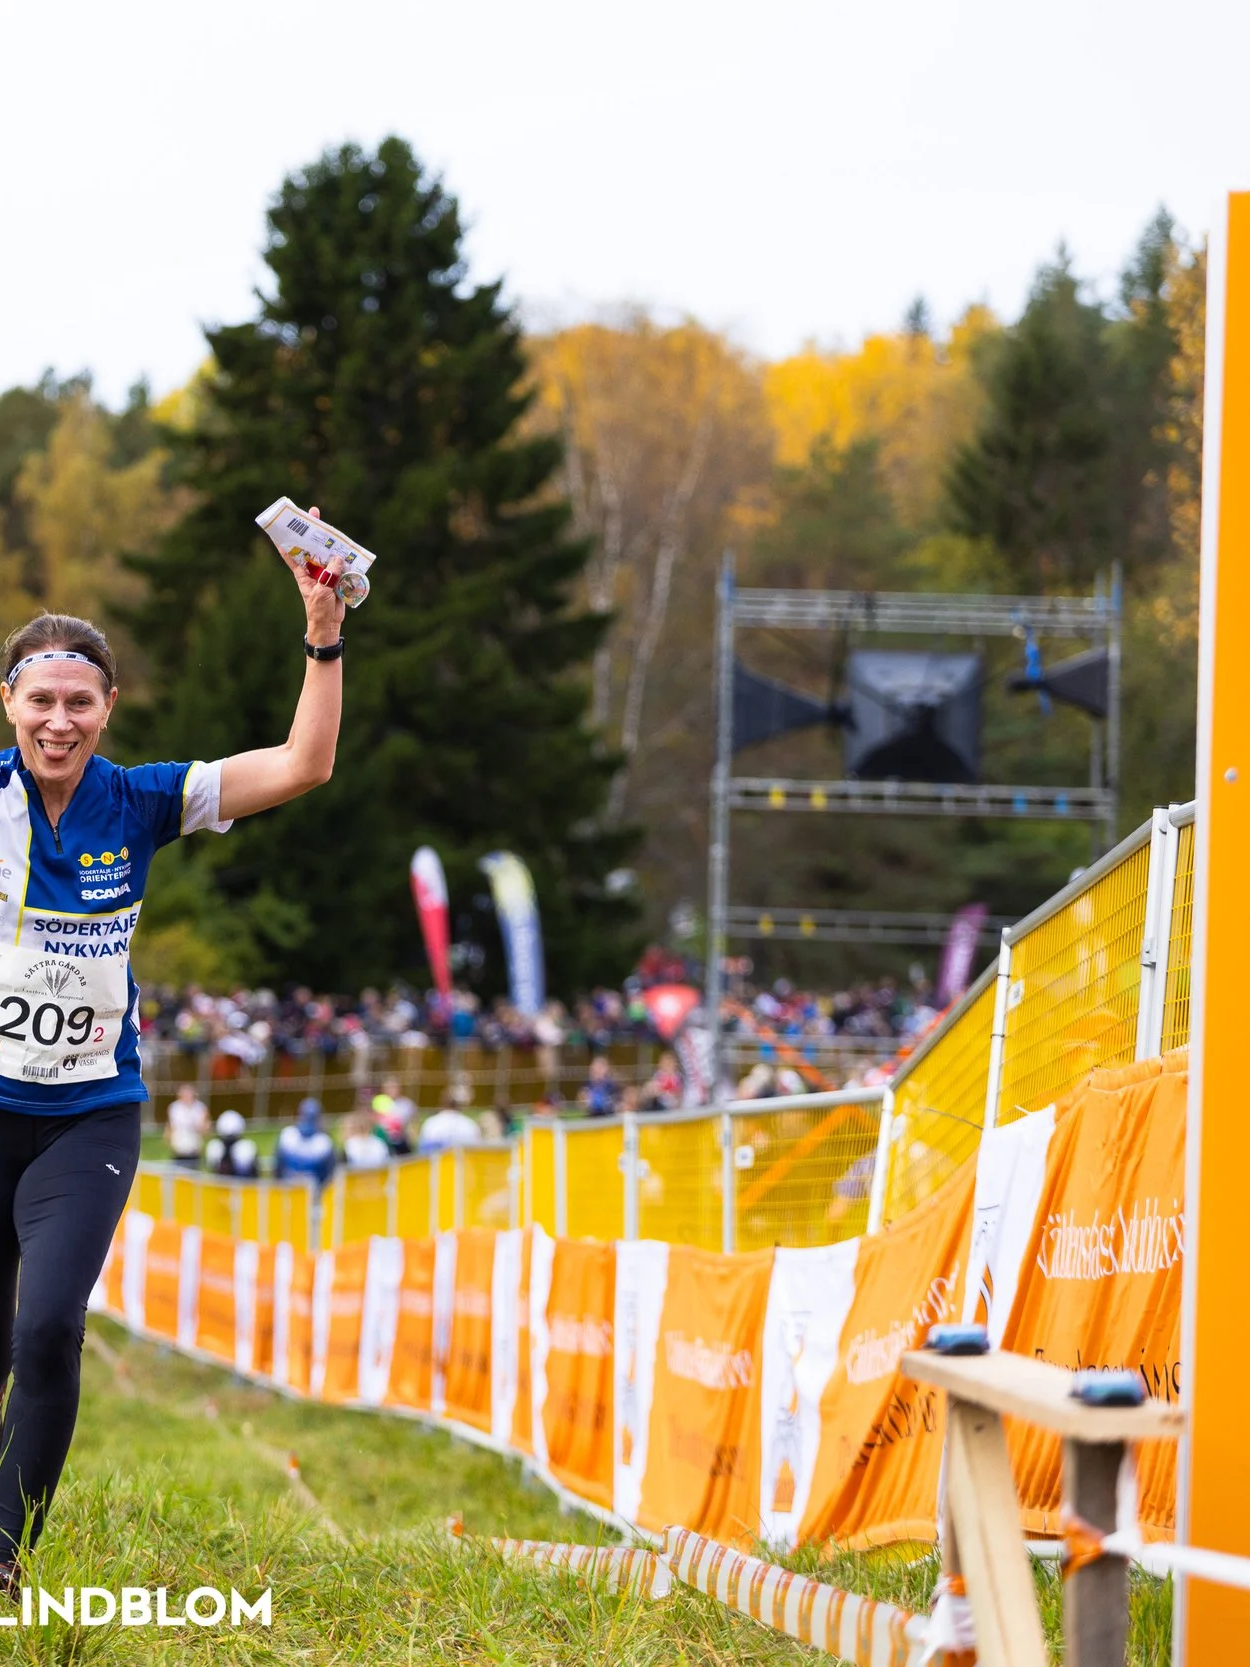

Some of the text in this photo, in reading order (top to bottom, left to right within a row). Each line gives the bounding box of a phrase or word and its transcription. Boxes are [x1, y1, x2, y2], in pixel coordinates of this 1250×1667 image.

[58, 961, 81, 976] GÅRD
[78, 976, 87, 987] AB
[93, 1026, 104, 1043] 2
